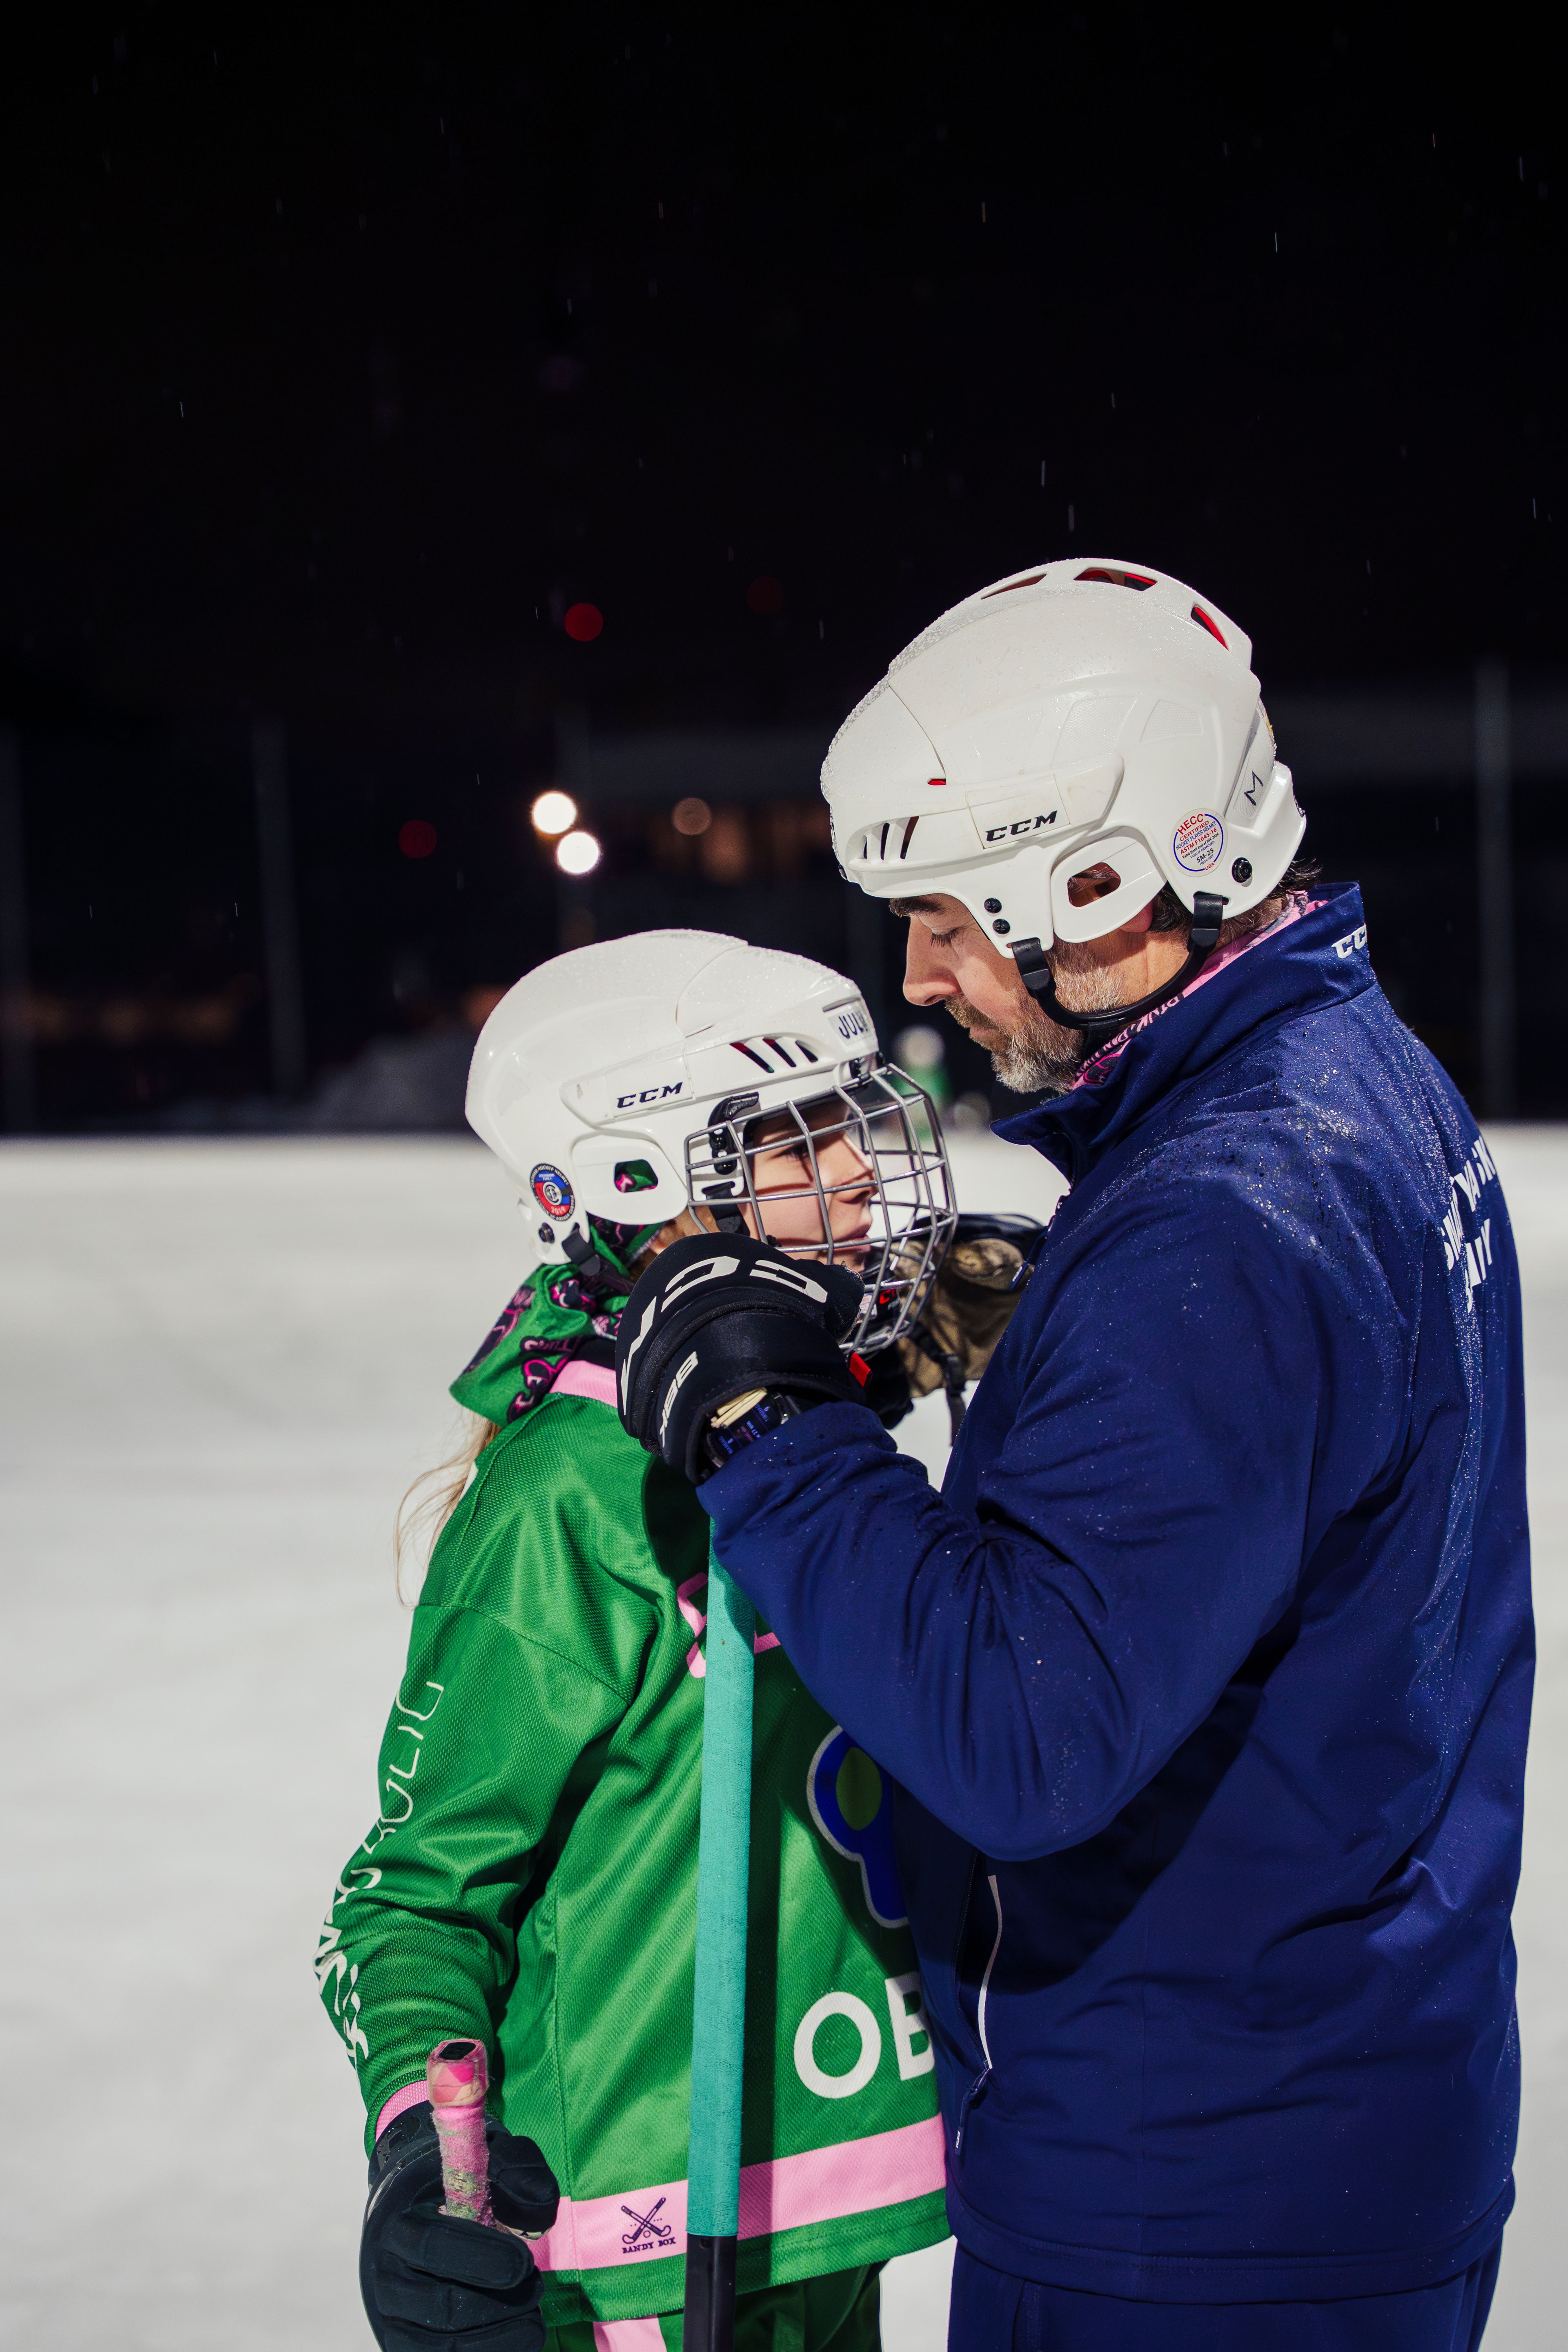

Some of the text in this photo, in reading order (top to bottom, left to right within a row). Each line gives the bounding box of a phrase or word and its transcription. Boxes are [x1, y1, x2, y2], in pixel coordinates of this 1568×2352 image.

[985, 810, 1058, 842] CCM
[1177, 813, 1203, 835] HECC
[1180, 820, 1209, 841] CERTIFIED
[1176, 821, 1216, 850] HOCKEY PLAYER HELMET
[1180, 827, 1217, 854] ASTM F1045-16
[1200, 840, 1215, 852] REMOVED
[1196, 848, 1214, 863] SM-25
[1200, 854, 1214, 865] HECC.NET
[1205, 862, 1215, 871] USA
[1331, 923, 1367, 959] CC
[617, 1082, 683, 1108] CCM
[622, 2237, 676, 2254] BANDY BOX
